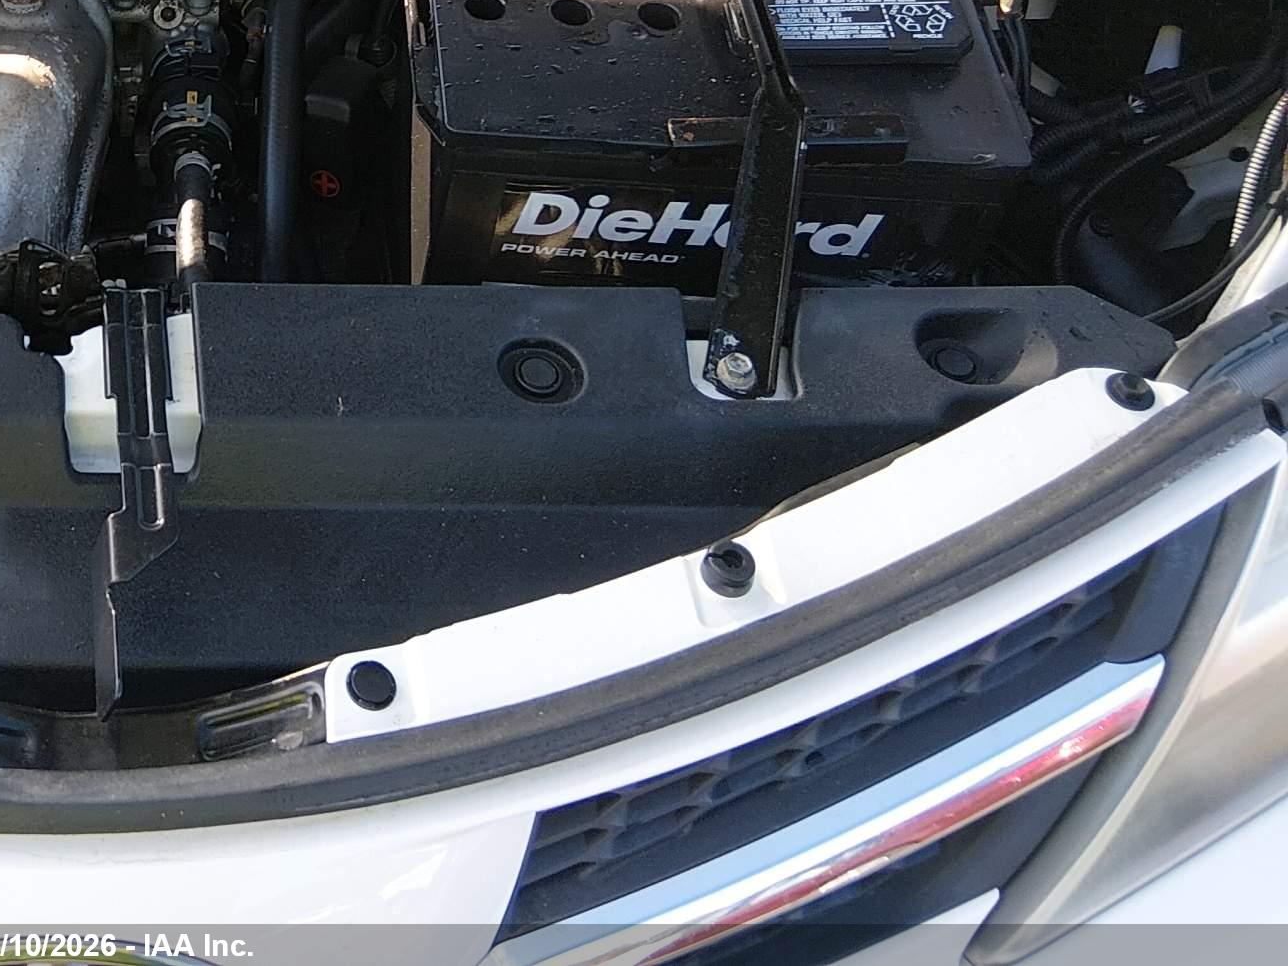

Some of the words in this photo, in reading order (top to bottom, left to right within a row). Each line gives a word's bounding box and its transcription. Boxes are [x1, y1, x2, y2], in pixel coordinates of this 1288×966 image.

[511, 192, 884, 257] DieHrd
[500, 242, 587, 258] POWER
[594, 250, 681, 264] AHEAD
